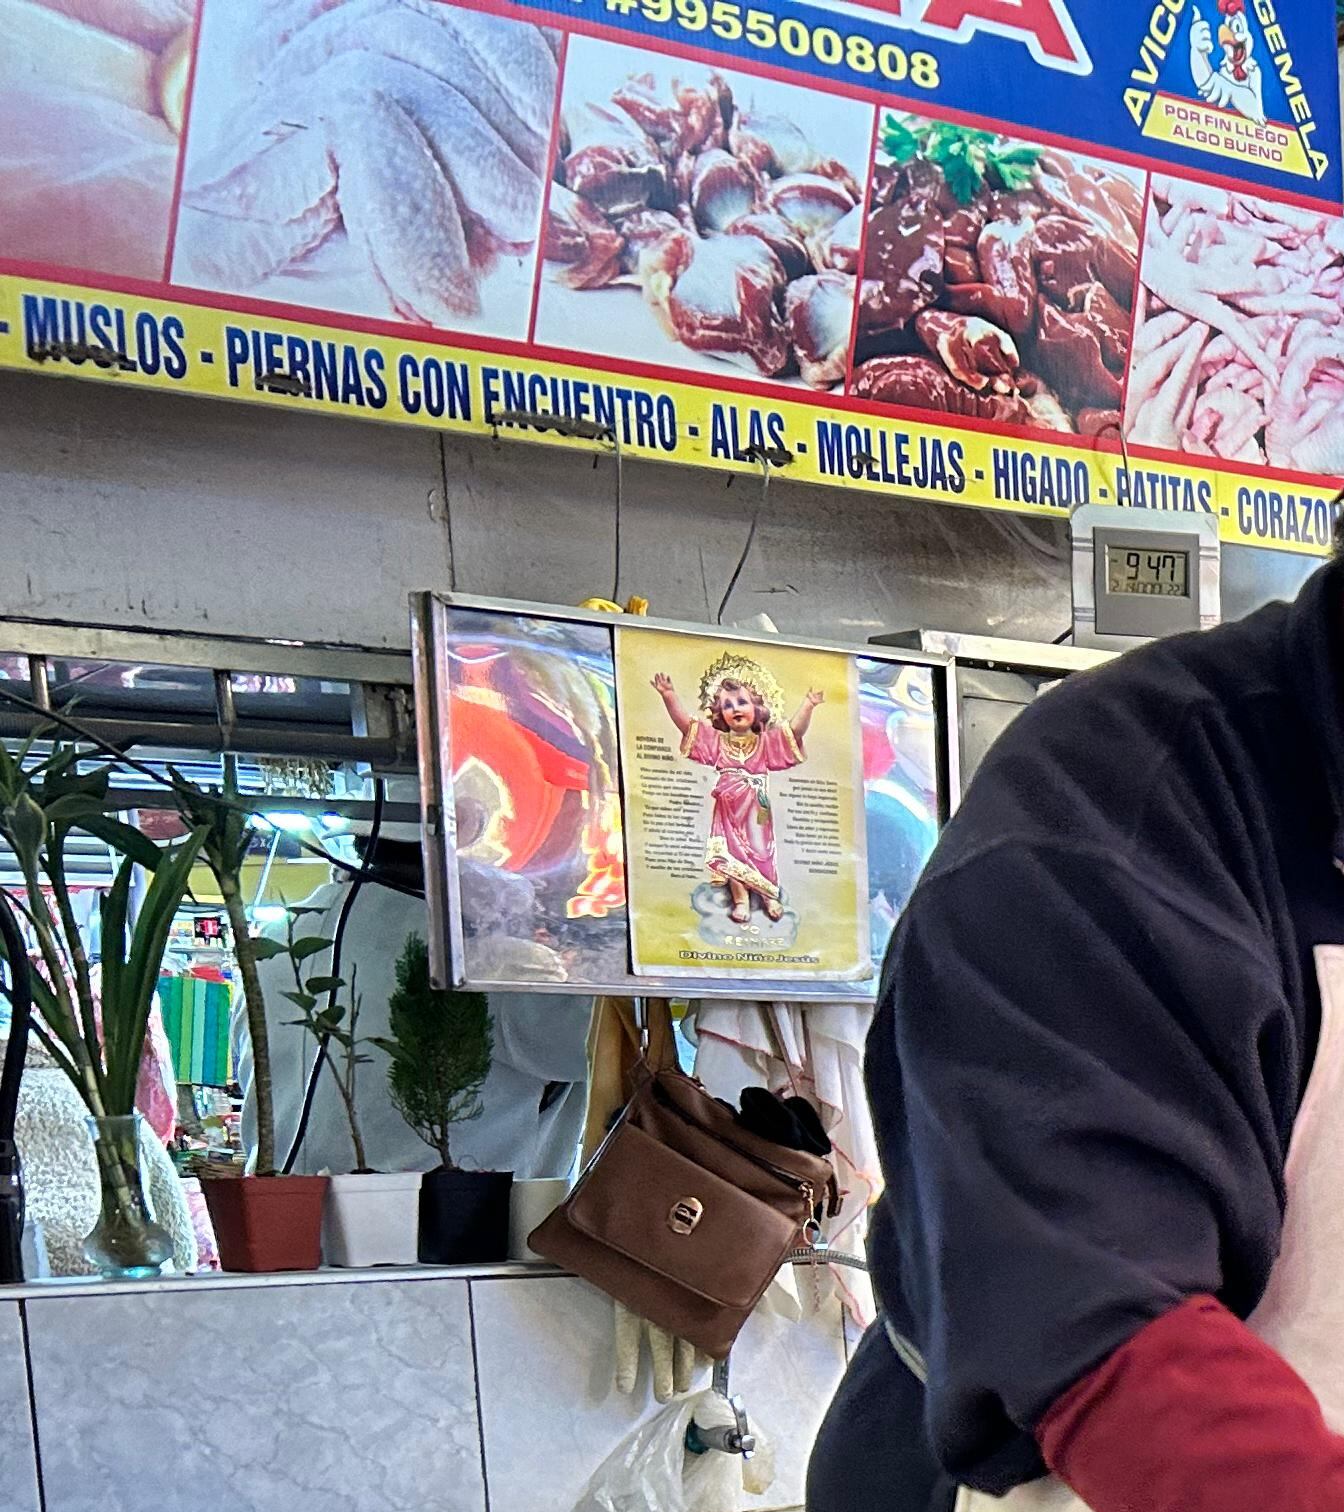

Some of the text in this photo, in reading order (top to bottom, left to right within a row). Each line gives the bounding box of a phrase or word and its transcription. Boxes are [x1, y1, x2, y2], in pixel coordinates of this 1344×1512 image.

[1164, 104, 1289, 147] POR FIN LLEGO
[1172, 124, 1283, 162] ALGO BUENO
[23, 295, 187, 378] MUSLOS
[226, 327, 387, 408] PIERNAS
[399, 355, 470, 420] CON
[484, 369, 676, 451] ENCUENTRO
[711, 404, 785, 463] ALAS
[818, 423, 965, 493] MOLLEJAS
[993, 448, 1089, 508] HIGADO
[1116, 467, 1212, 514] PATITAS
[679, 950, 734, 961] Divino
[735, 952, 774, 962] Niño
